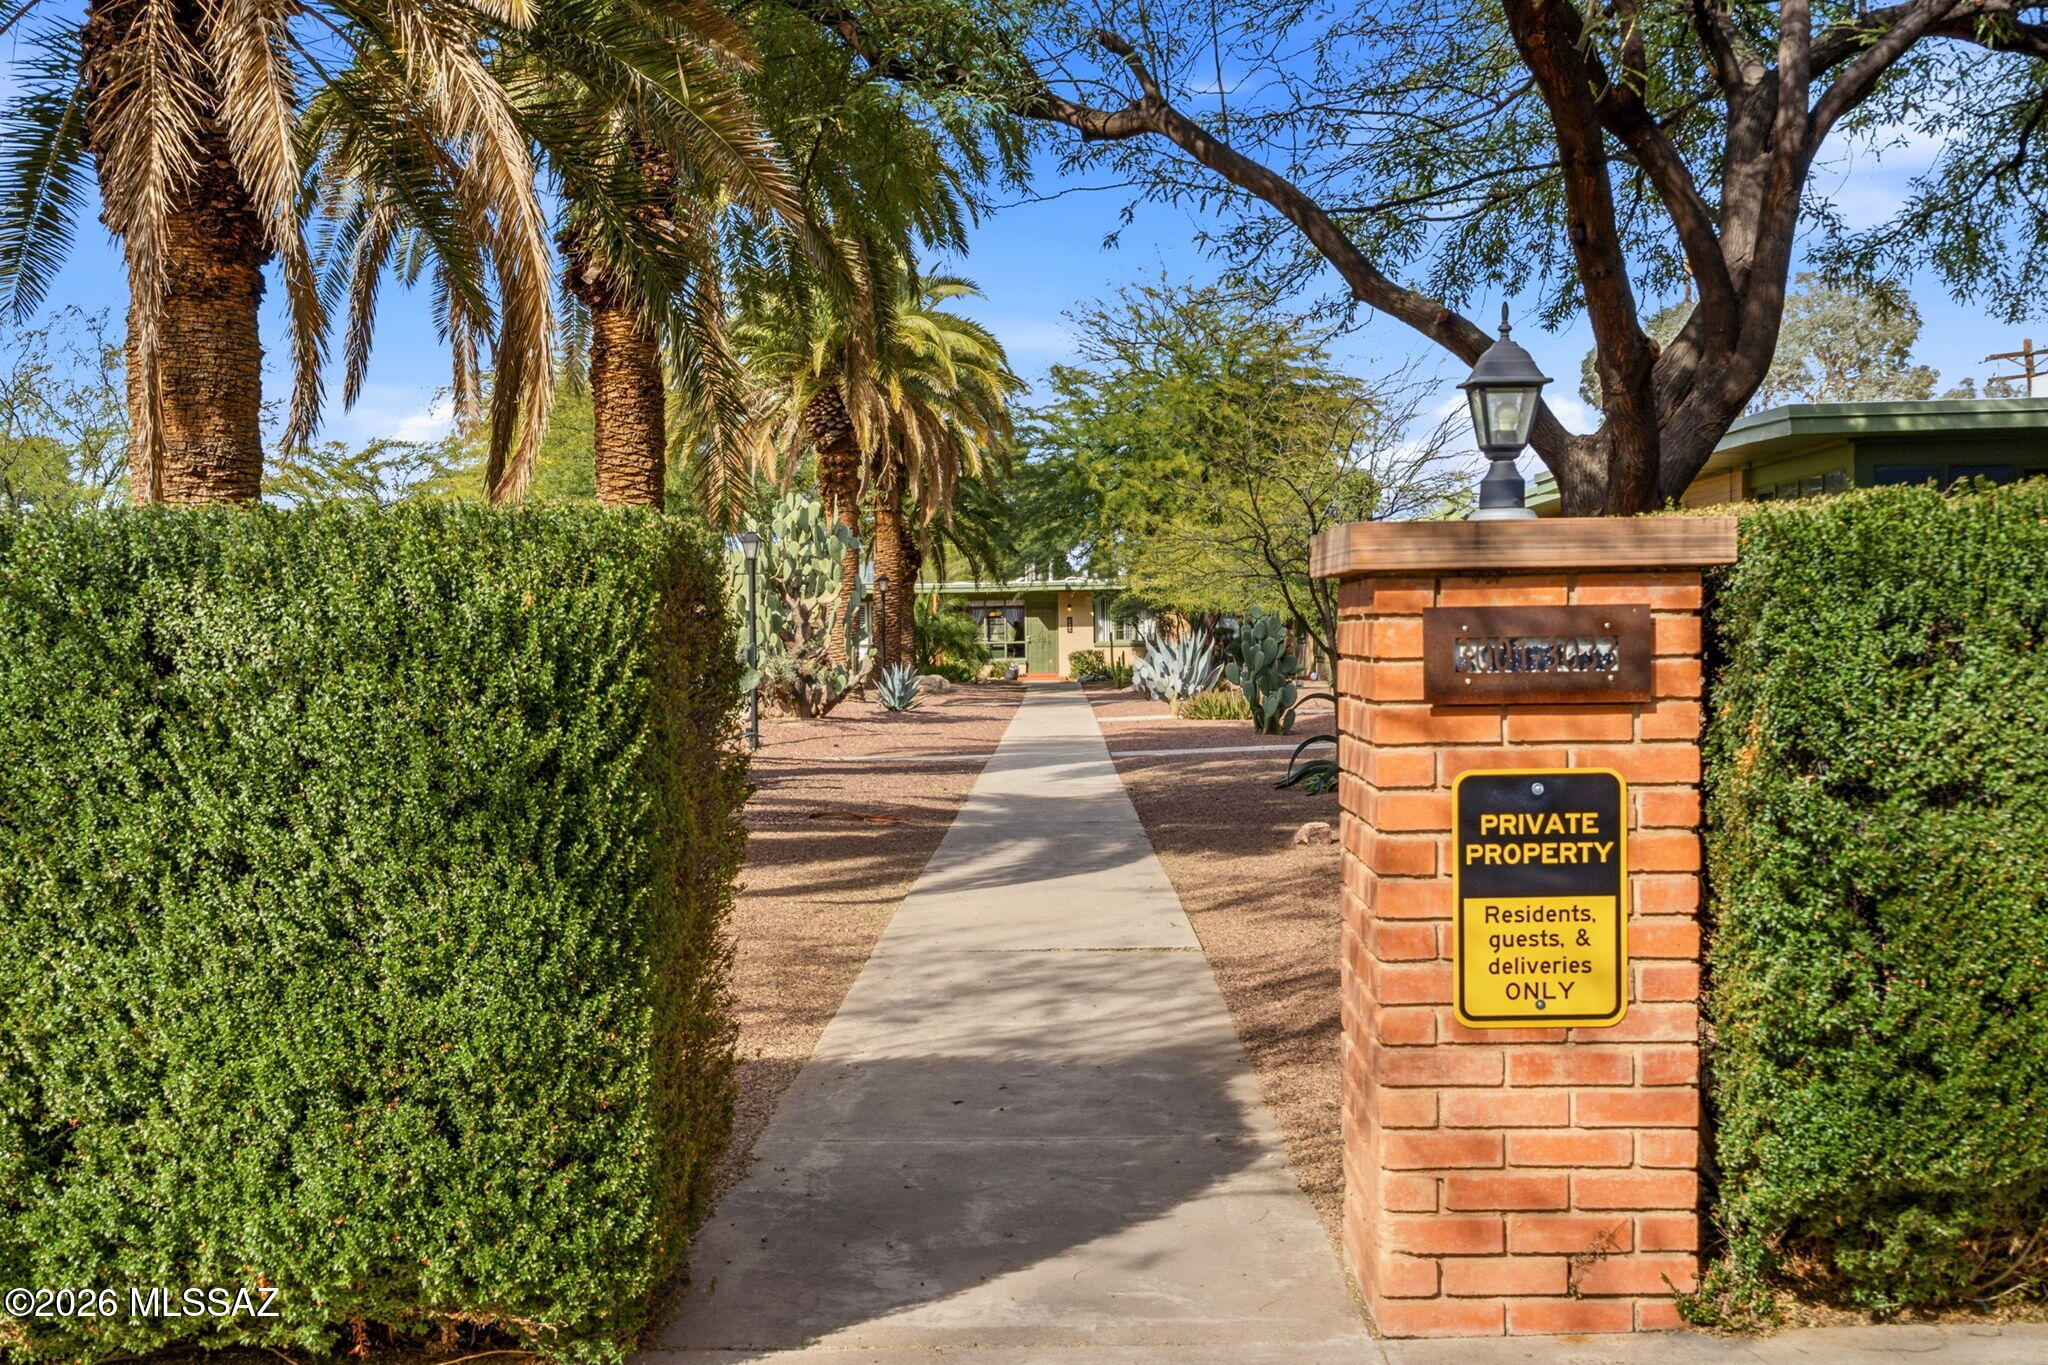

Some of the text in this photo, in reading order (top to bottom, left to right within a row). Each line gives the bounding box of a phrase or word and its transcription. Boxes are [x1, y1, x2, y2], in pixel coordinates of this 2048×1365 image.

[1480, 812, 1600, 836] PRIVATE
[1466, 841, 1614, 865] PROPERTY
[1485, 904, 1597, 924] Residents,
[1489, 928, 1592, 953] guests, &
[1488, 956, 1593, 975] deliveries
[1505, 981, 1575, 1001] ONLY
